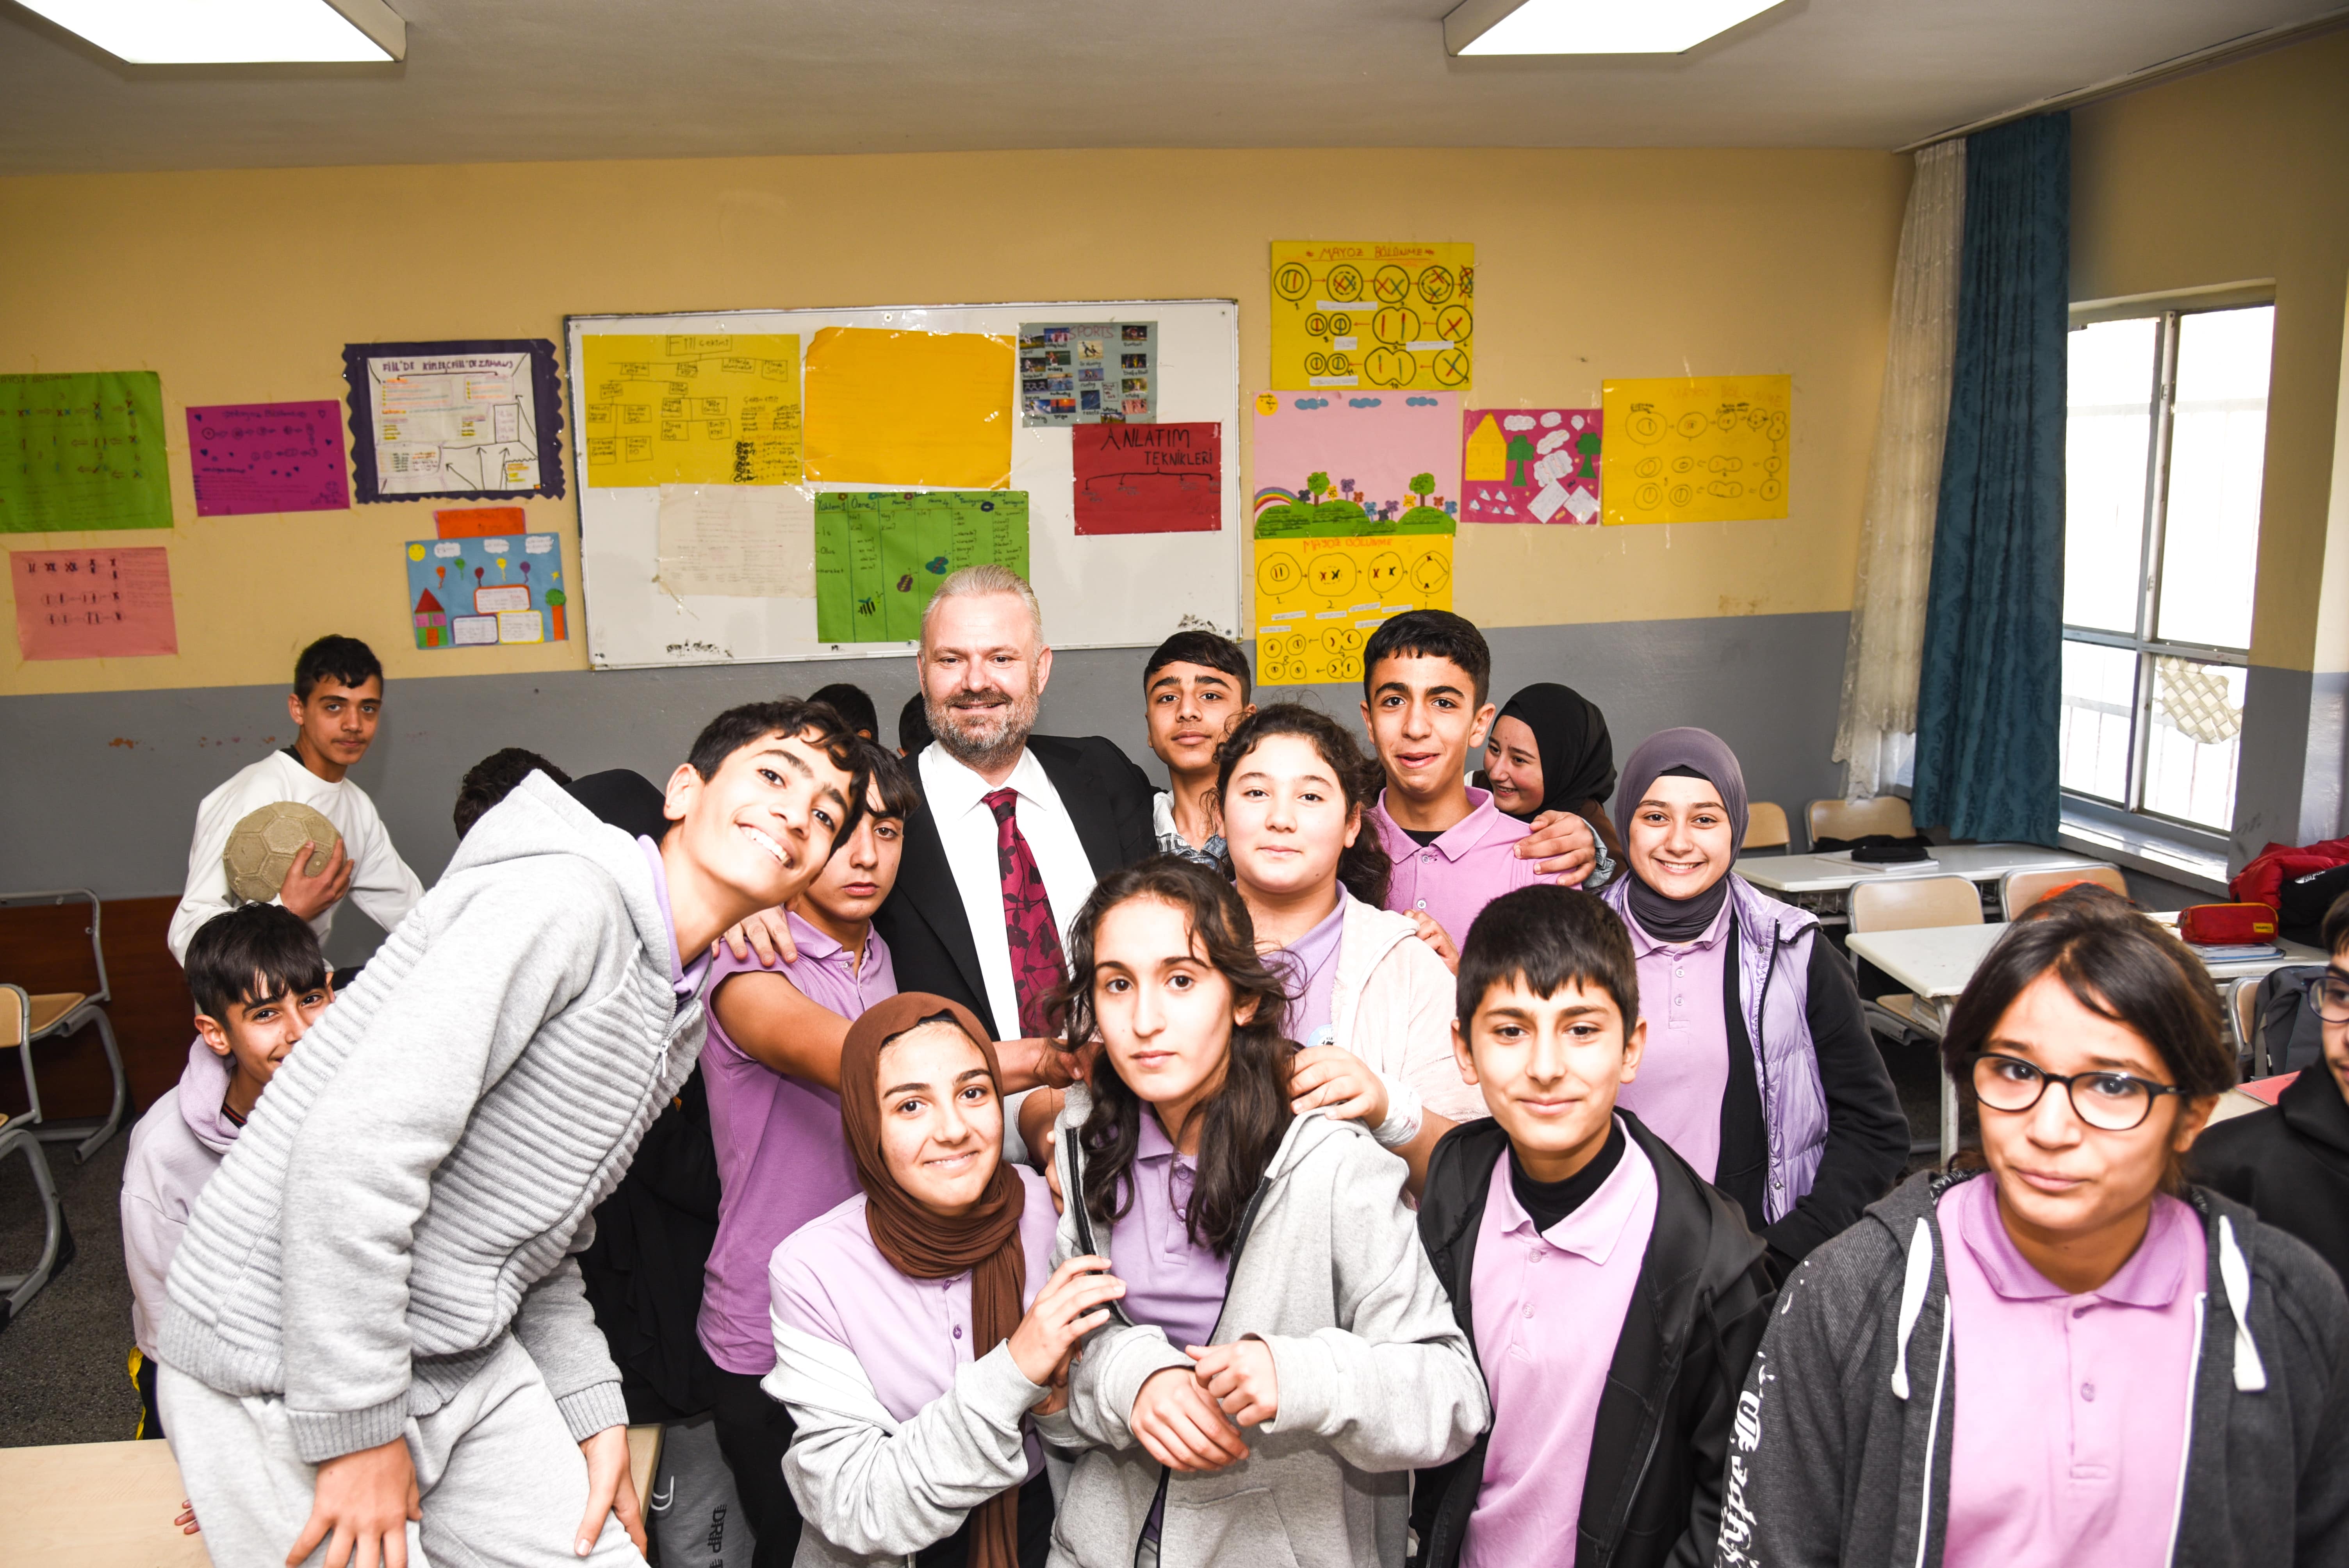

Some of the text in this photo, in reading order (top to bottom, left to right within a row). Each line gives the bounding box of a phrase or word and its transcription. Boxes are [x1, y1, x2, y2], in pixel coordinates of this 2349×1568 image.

[1319, 248, 1363, 260] MAYOZ
[1068, 325, 1114, 341] SPORTS
[1101, 428, 1189, 450] ANLATIM
[1144, 448, 1212, 465] TEKNİKLERİ
